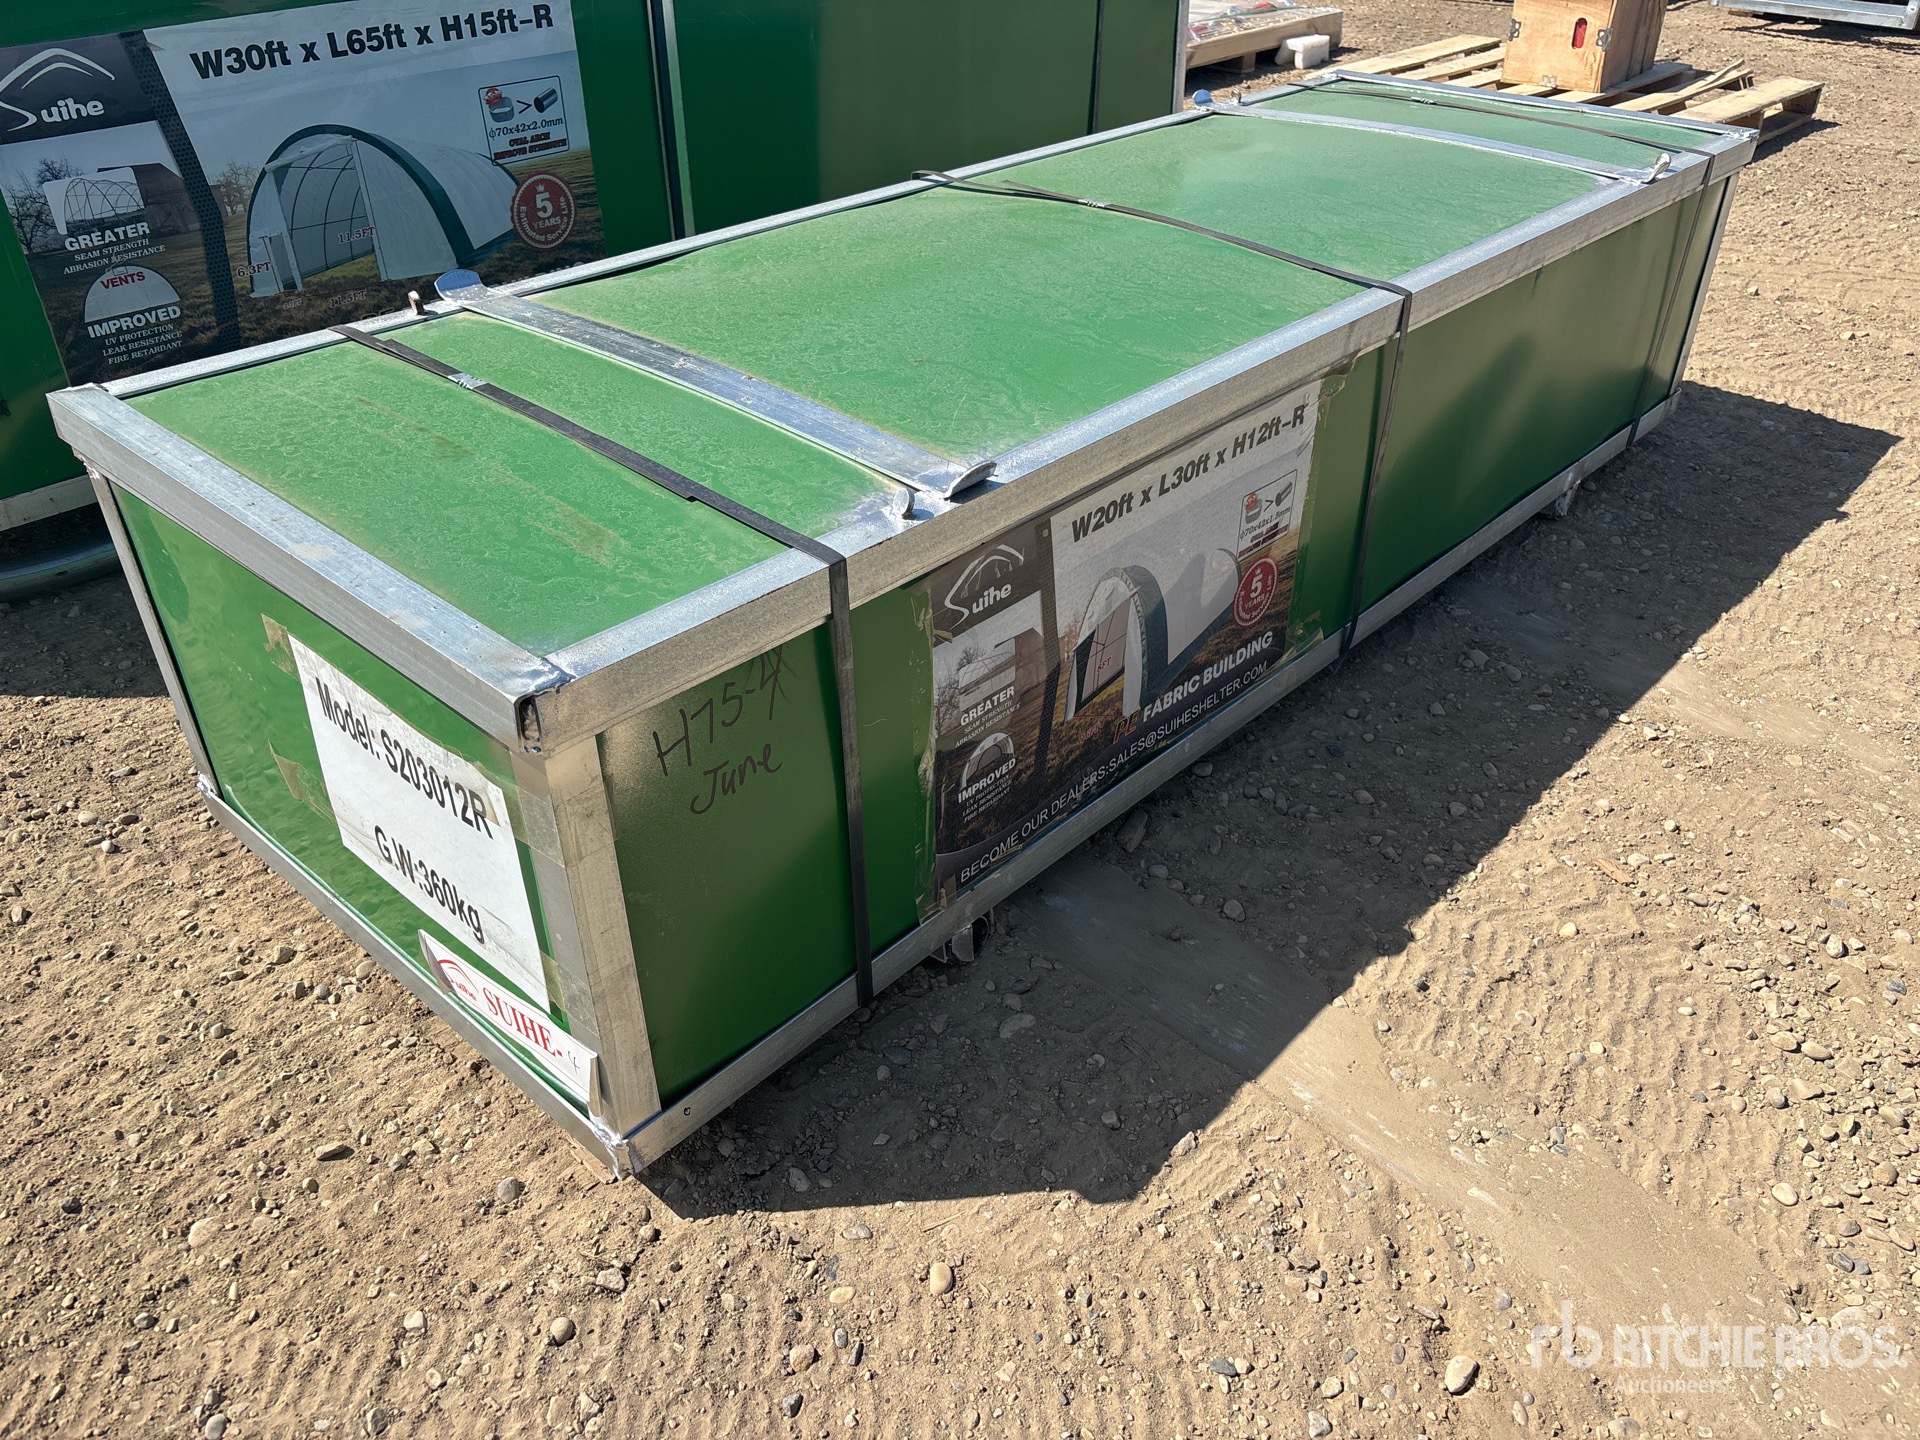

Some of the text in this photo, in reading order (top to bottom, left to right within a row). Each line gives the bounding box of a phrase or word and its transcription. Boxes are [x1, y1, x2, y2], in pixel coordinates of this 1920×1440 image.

[189, 4, 553, 80] W30ft x L65ft x H15ft-R
[535, 192, 553, 218] 5
[65, 222, 150, 251] GREATER
[338, 226, 375, 244] 11.5FT
[520, 206, 545, 241] Estimated
[547, 216, 568, 241] Service
[532, 216, 561, 230] YEARS
[63, 244, 166, 274] ABRASION RESISTANCE
[74, 238, 149, 262] SEAM STRENGTH
[100, 271, 146, 290] VENTS
[237, 261, 271, 278] 6.3FT
[87, 306, 181, 339] IMPROVED
[105, 323, 174, 346] UV PROTECTION
[103, 331, 183, 357] LEAK RESISTANCE
[108, 340, 183, 365] FIRE RETARDANT
[1071, 404, 1306, 543] W20ft x L30ft x H12ft-R
[1244, 593, 1265, 609] YEARS
[1250, 573, 1263, 598] 5
[1113, 709, 1140, 745] PE
[1143, 674, 1200, 722] FABRIC
[1203, 631, 1273, 686] BUILDING
[960, 685, 1015, 726] GREATER
[964, 700, 1012, 734] SEAM STRENGTH
[955, 702, 1021, 748] ABRASION RESISTANCE
[315, 676, 494, 840] Model: S203012R
[690, 744, 782, 815] June
[958, 758, 1016, 803] IMPROVED
[975, 774, 1010, 800] PROTECTION
[962, 779, 1012, 817] LEAK RESISTANCE
[964, 787, 1011, 823] FIRE RETARDANT
[960, 833, 1019, 883] BECOME
[1021, 808, 1049, 837] OUR
[374, 824, 485, 945] G.W:360kg
